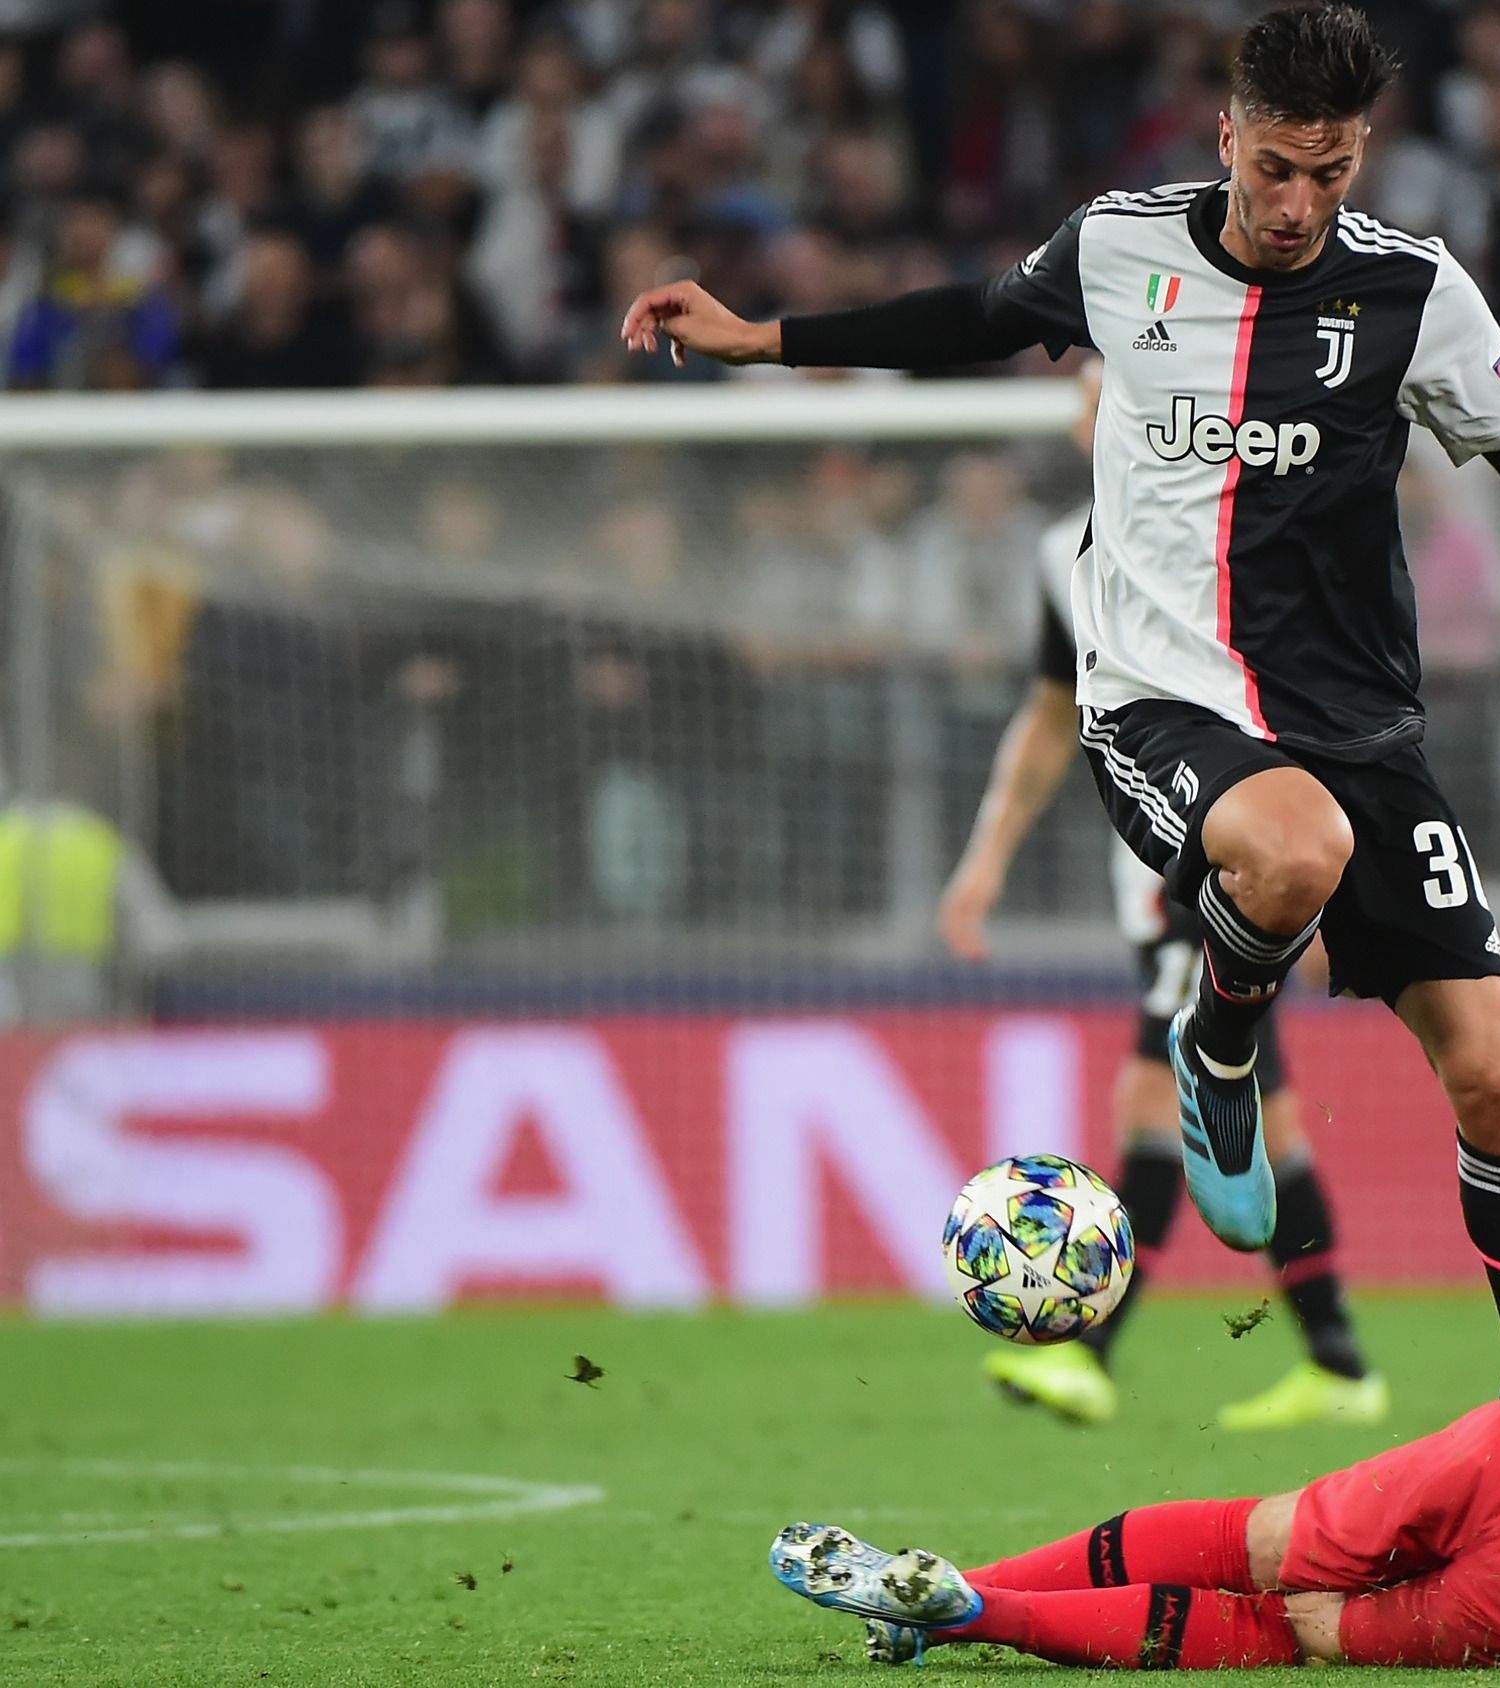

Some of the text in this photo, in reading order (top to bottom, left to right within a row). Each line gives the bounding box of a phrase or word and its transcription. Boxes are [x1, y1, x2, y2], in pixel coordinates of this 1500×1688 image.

[1132, 339, 1178, 352] adidas
[1146, 396, 1321, 476] Jeep
[1413, 820, 1490, 910] 3
[22, 1022, 1085, 1317] SAN
